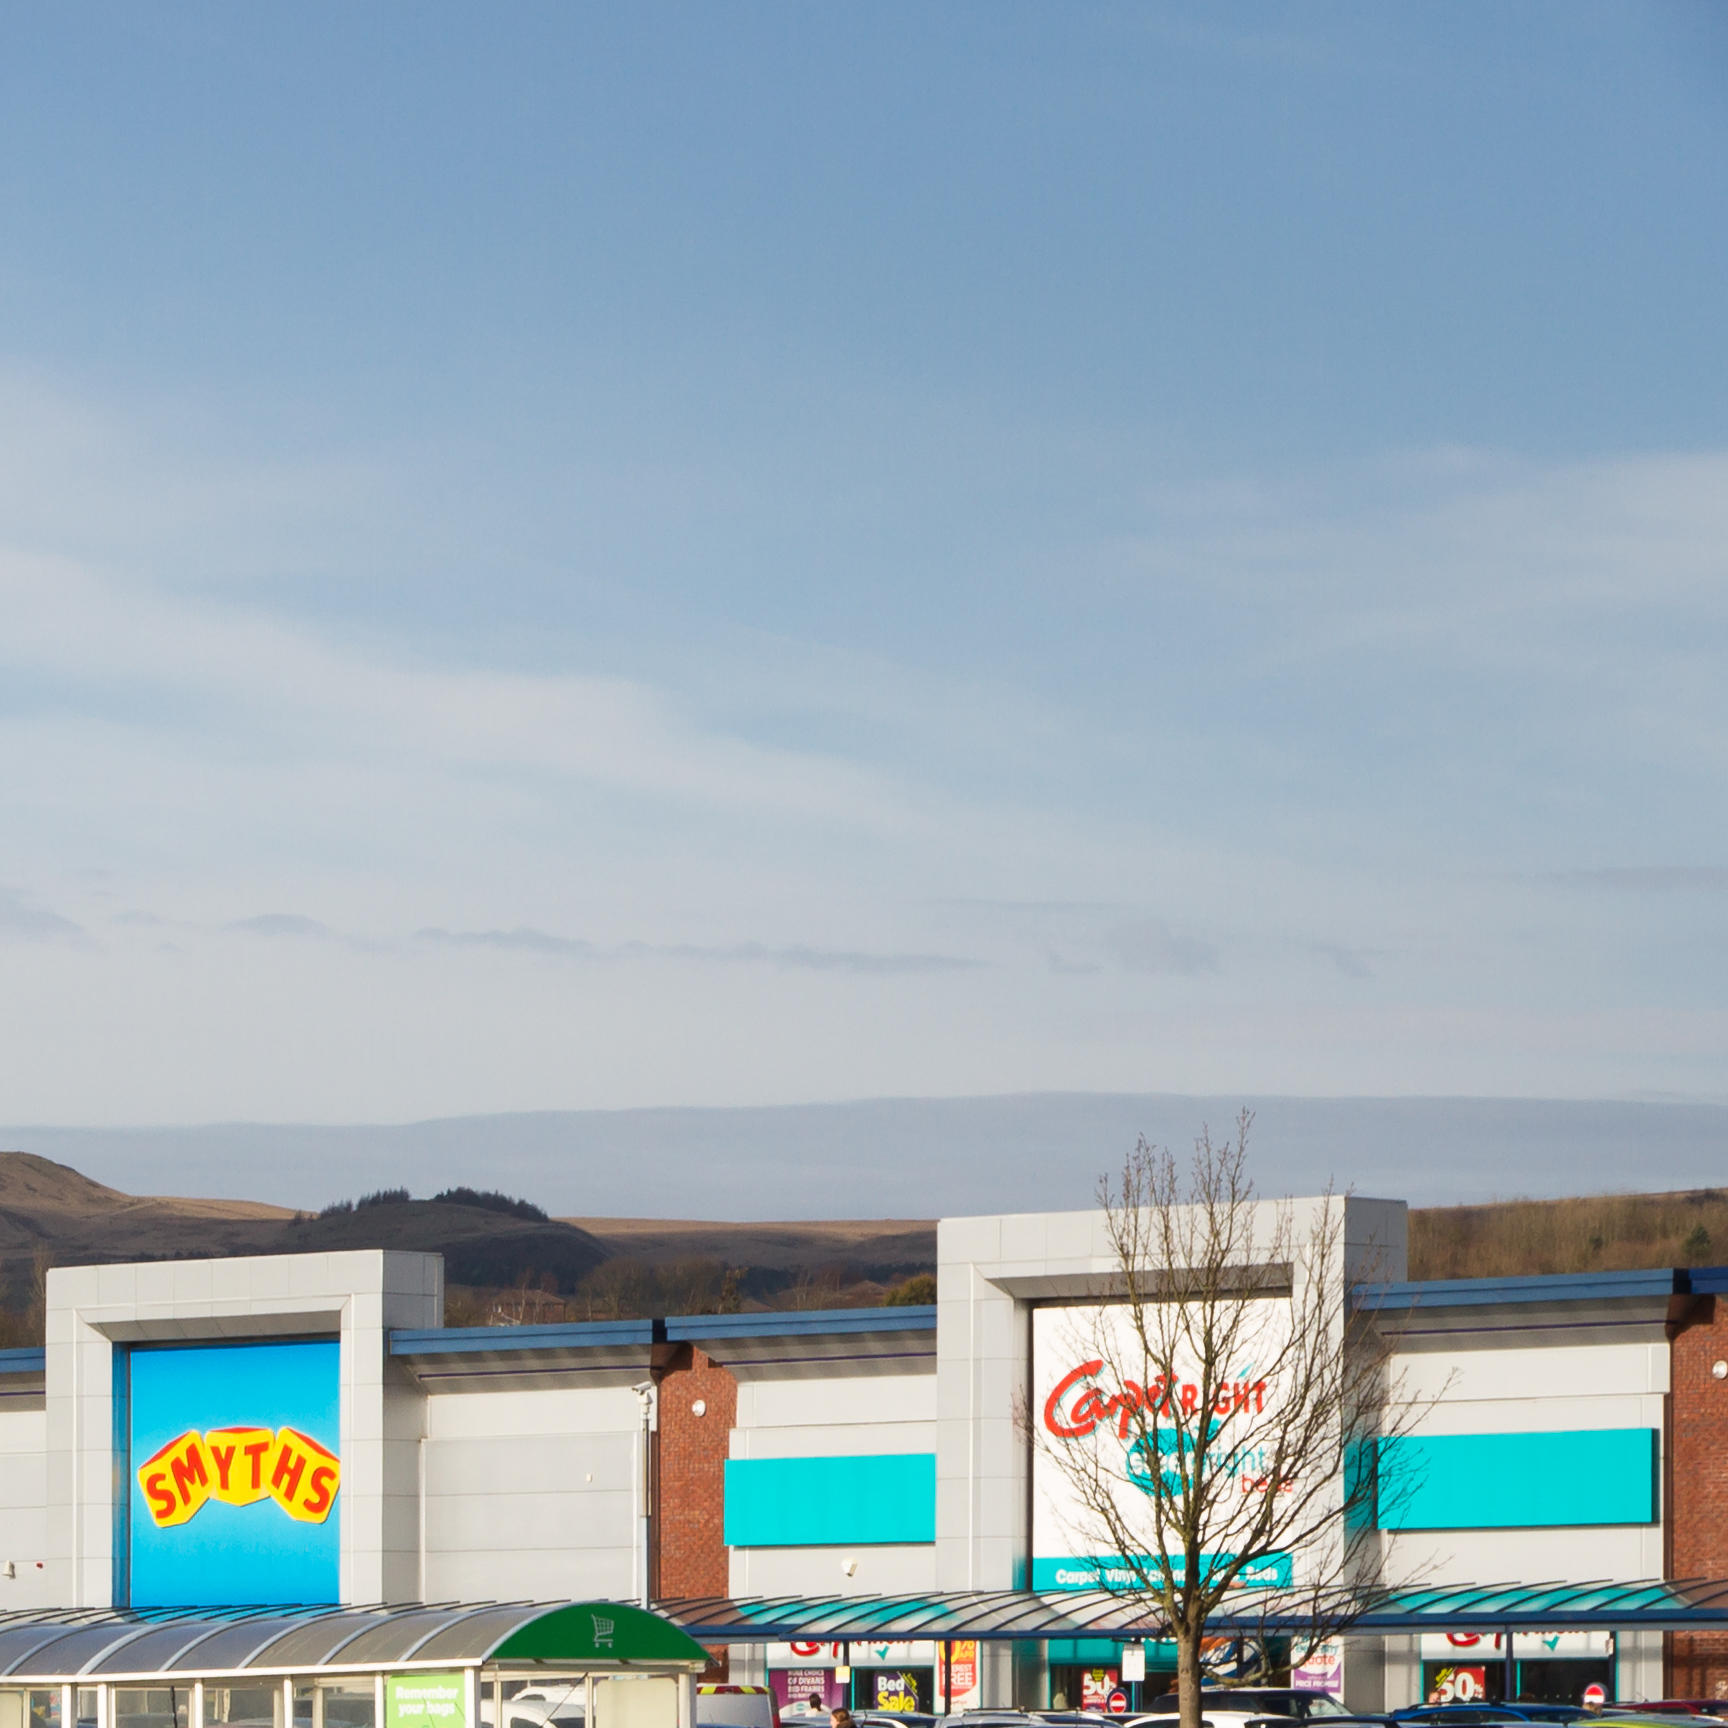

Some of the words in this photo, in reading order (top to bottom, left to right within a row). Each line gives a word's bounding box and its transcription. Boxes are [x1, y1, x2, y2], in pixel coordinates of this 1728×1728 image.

[146, 1441, 337, 1520] SMYTHS
[877, 1676, 905, 1691] Bed
[395, 1686, 459, 1700] Remember
[877, 1691, 916, 1712] Sale
[398, 1703, 424, 1718] your
